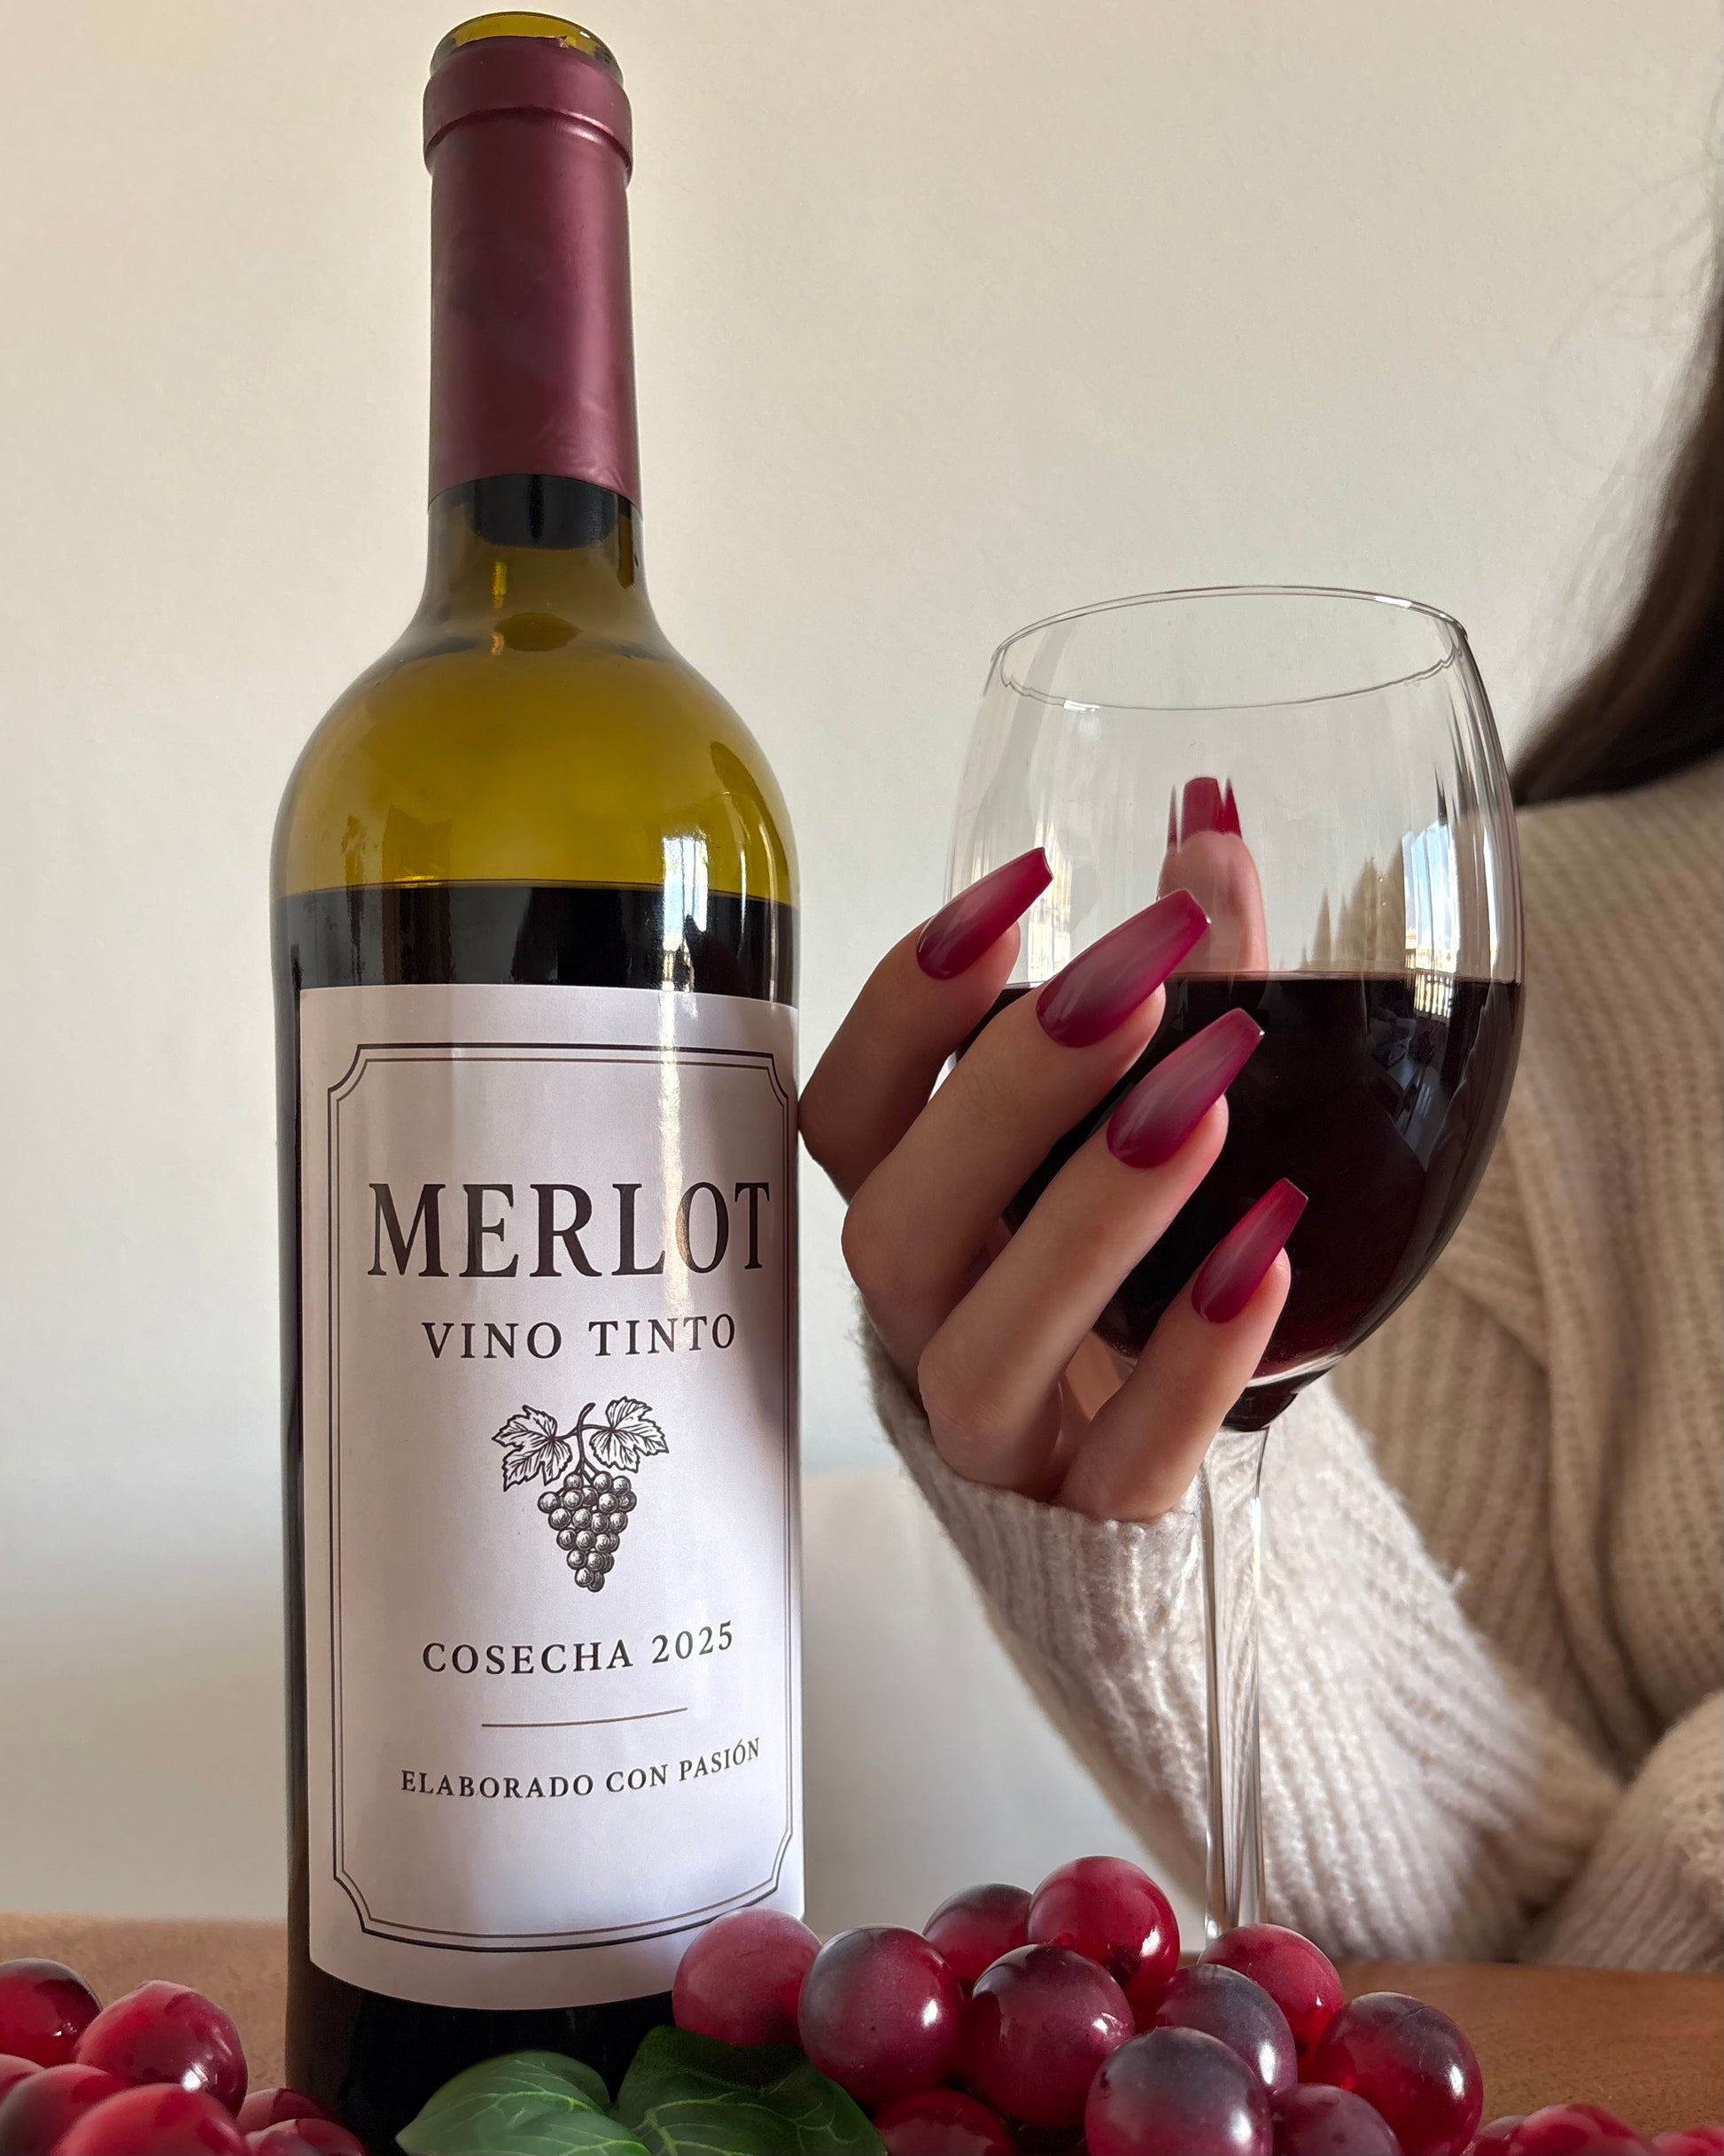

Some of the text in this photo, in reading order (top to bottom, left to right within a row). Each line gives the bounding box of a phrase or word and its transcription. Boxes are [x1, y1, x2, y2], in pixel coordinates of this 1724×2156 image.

[367, 1181, 770, 1278] MERLOT
[421, 1313, 736, 1359] VINO TINTO
[422, 1620, 734, 1675] COSECHA 2025
[400, 1737, 761, 1799] ELABORADO CON PASIÓN
